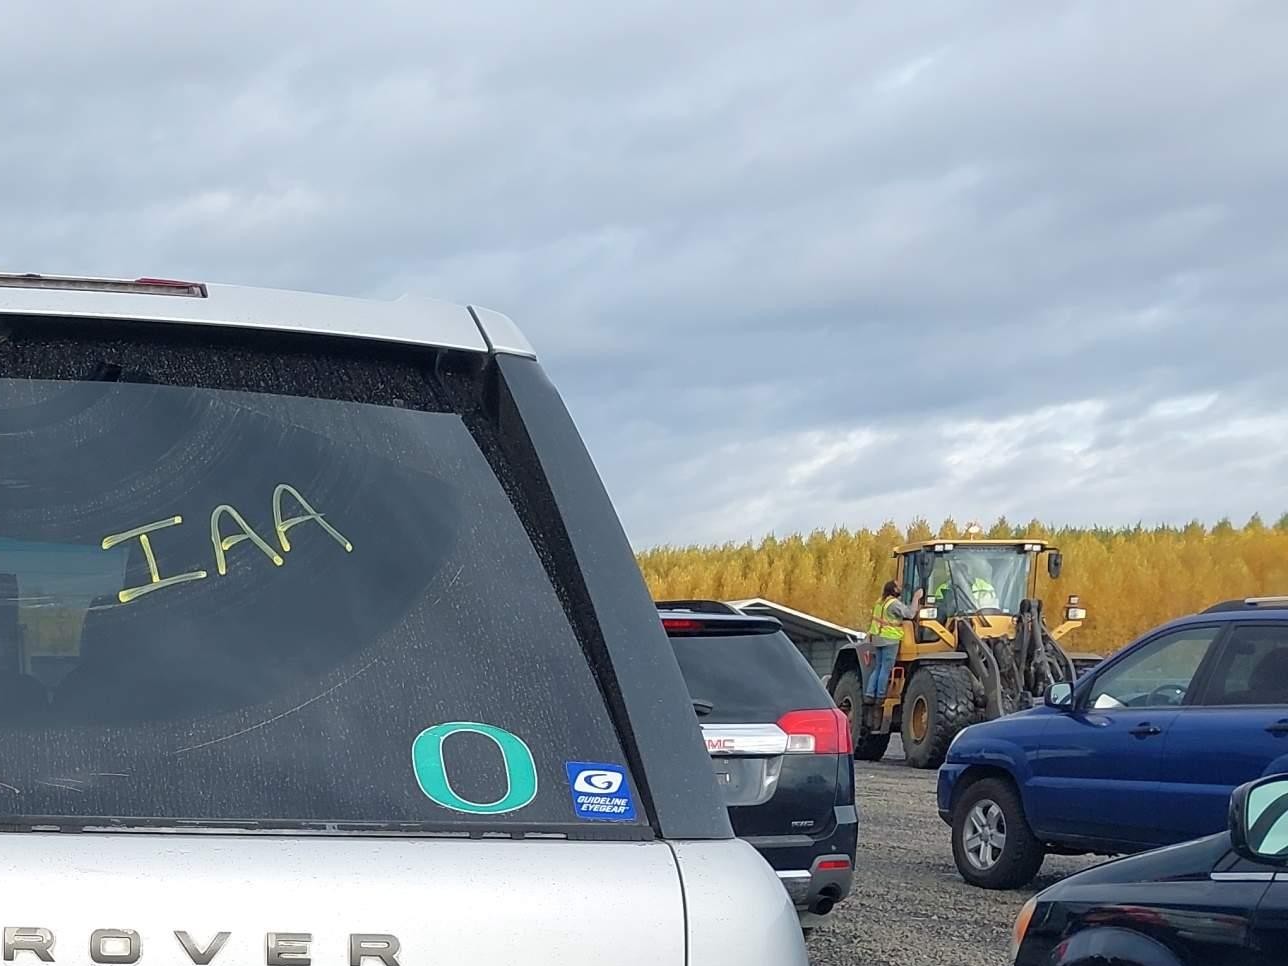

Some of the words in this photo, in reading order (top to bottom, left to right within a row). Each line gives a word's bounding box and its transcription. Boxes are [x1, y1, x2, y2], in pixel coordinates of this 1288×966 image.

[101, 483, 353, 602] IAA
[705, 739, 735, 750] MC
[577, 795, 629, 806] GUIDELINE
